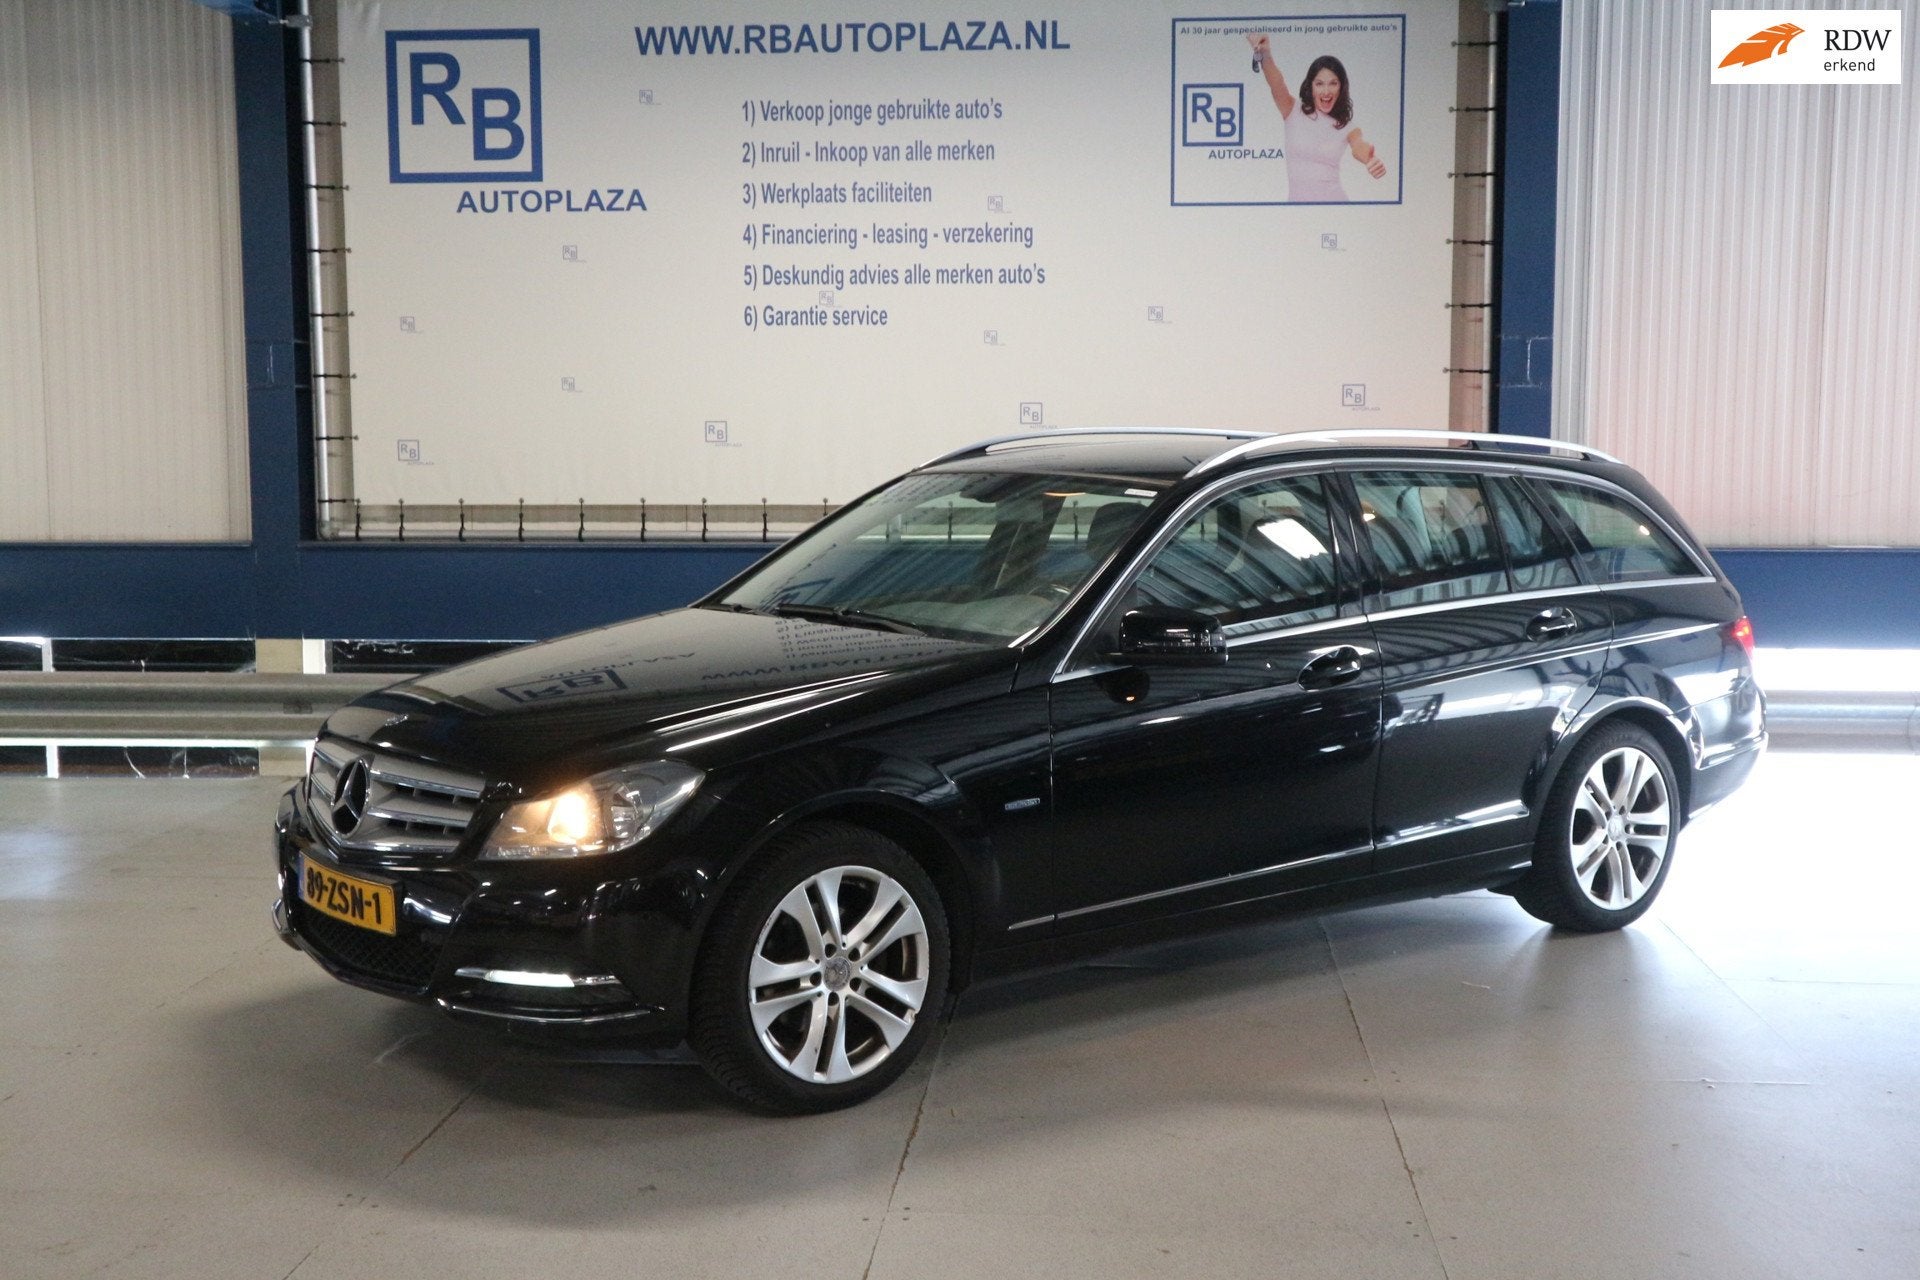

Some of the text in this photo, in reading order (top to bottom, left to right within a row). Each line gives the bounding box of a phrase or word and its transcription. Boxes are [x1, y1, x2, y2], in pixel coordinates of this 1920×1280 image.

[634, 20, 1070, 56] WWW.RBAUTOPLAZA.NL
[1204, 26, 1221, 36] jaar
[1223, 25, 1292, 36] gespecialiseerd
[1294, 25, 1303, 33] in
[1304, 25, 1325, 35] jong
[1327, 24, 1369, 35] gebruikte
[1371, 23, 1398, 33] auto's
[409, 51, 525, 162] RB
[742, 98, 1003, 127] 1) Verkoop jonge gebruikte auto's
[1191, 92, 1237, 138] RB
[742, 142, 756, 169] 2)
[761, 141, 800, 163] Inruil
[815, 141, 868, 167] Inkoop
[873, 146, 901, 162] van
[906, 140, 933, 162] alle
[938, 140, 995, 161] merken
[1208, 148, 1284, 160] AUTOPLAZA
[456, 189, 647, 213] AUTOPLAZA
[743, 182, 932, 209] 3) Werkplaats faciliteiten
[743, 224, 758, 250] 4)
[762, 223, 858, 250] Financiering
[873, 223, 928, 250] leasing
[943, 222, 1034, 249] verzekering
[744, 262, 1046, 292] 5) Deskundig advies alle merken auto's
[744, 304, 888, 330] 6) Garantie service
[1345, 388, 1362, 403] RB
[1023, 407, 1039, 421] RB
[708, 425, 724, 439] RB
[400, 444, 417, 458] RB
[306, 867, 382, 925] 89-ZSN-1
